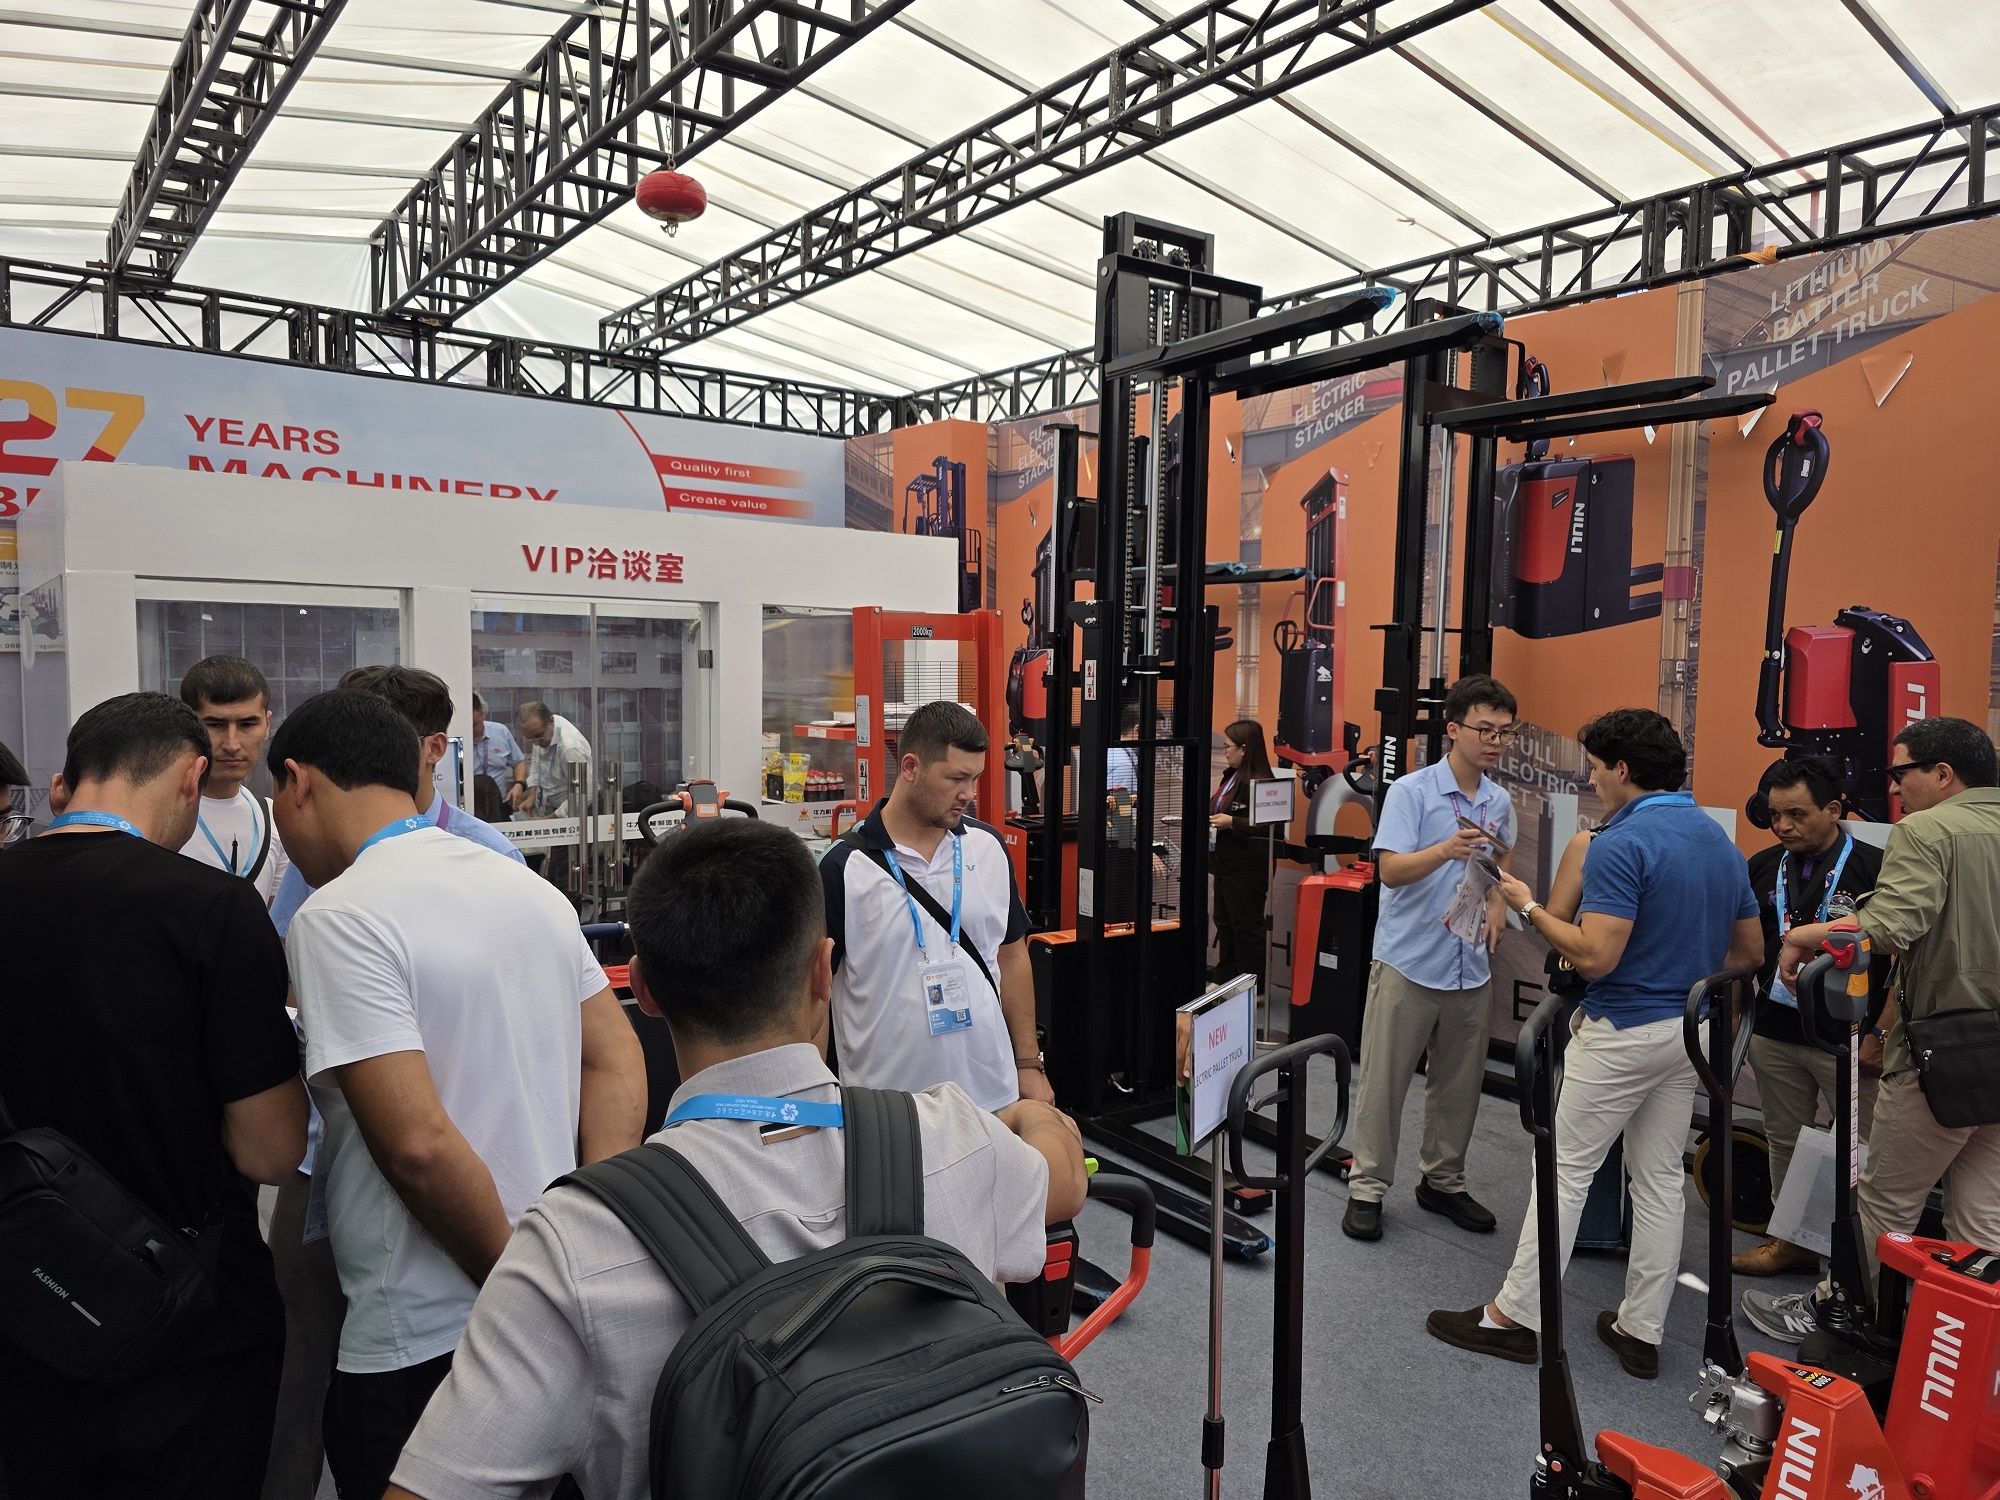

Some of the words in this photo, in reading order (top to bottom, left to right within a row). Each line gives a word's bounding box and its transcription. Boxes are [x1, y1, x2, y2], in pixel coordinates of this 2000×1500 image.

[1771, 240, 1888, 314] LITHIUM
[1773, 272, 1880, 343] BATTER
[1727, 329, 1825, 395] PALLET
[1831, 278, 1930, 345] TRUCK
[1294, 394, 1365, 449] STACKER
[1295, 371, 1367, 428] ELECTRIC
[0, 378, 146, 476] 27
[184, 413, 341, 456] YEARS
[1029, 418, 1050, 445] FUL
[670, 460, 720, 477] Quality
[724, 467, 751, 479] first
[1018, 454, 1056, 490] STACKE
[679, 492, 727, 508] Create
[730, 499, 768, 511] value
[1570, 502, 1586, 554] NIULI
[521, 544, 684, 584] VIP洽谈室
[912, 627, 933, 638] 2000kg
[1382, 735, 1397, 784] NIULI
[1208, 1022, 1228, 1050] NEW
[1194, 1066, 1213, 1089] LECTRIC
[1212, 1055, 1229, 1075] PALLET
[1228, 1045, 1244, 1065] TRUCK
[32, 1267, 70, 1299] FASHION
[1920, 1310, 1966, 1421] NIULI
